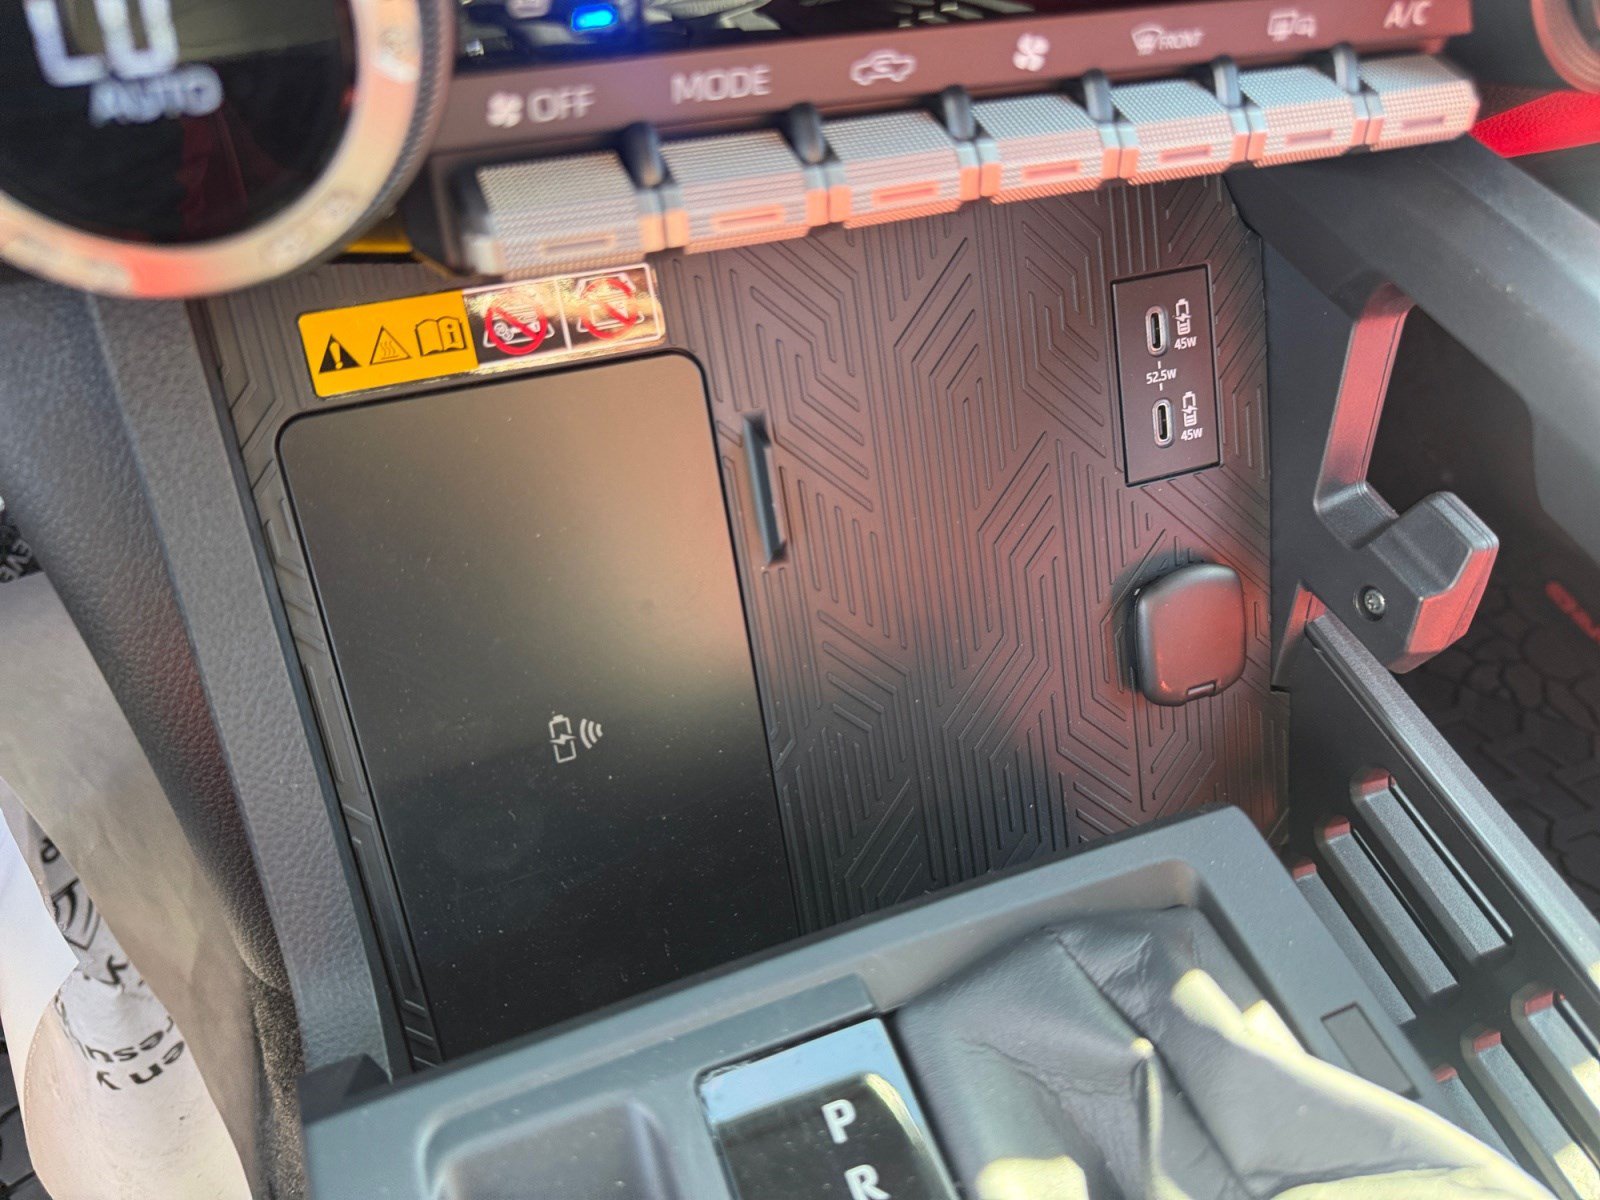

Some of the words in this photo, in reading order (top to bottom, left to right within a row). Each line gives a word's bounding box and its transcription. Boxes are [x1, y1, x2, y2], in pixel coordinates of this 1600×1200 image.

[1383, 0, 1432, 29] A/C
[671, 64, 772, 105] MODE
[527, 84, 596, 123] OFF
[1174, 336, 1197, 350] 45W
[1146, 368, 1177, 384] 52.5W
[1180, 427, 1203, 441] 45W
[821, 1098, 857, 1144] P
[844, 1164, 891, 1200] R
